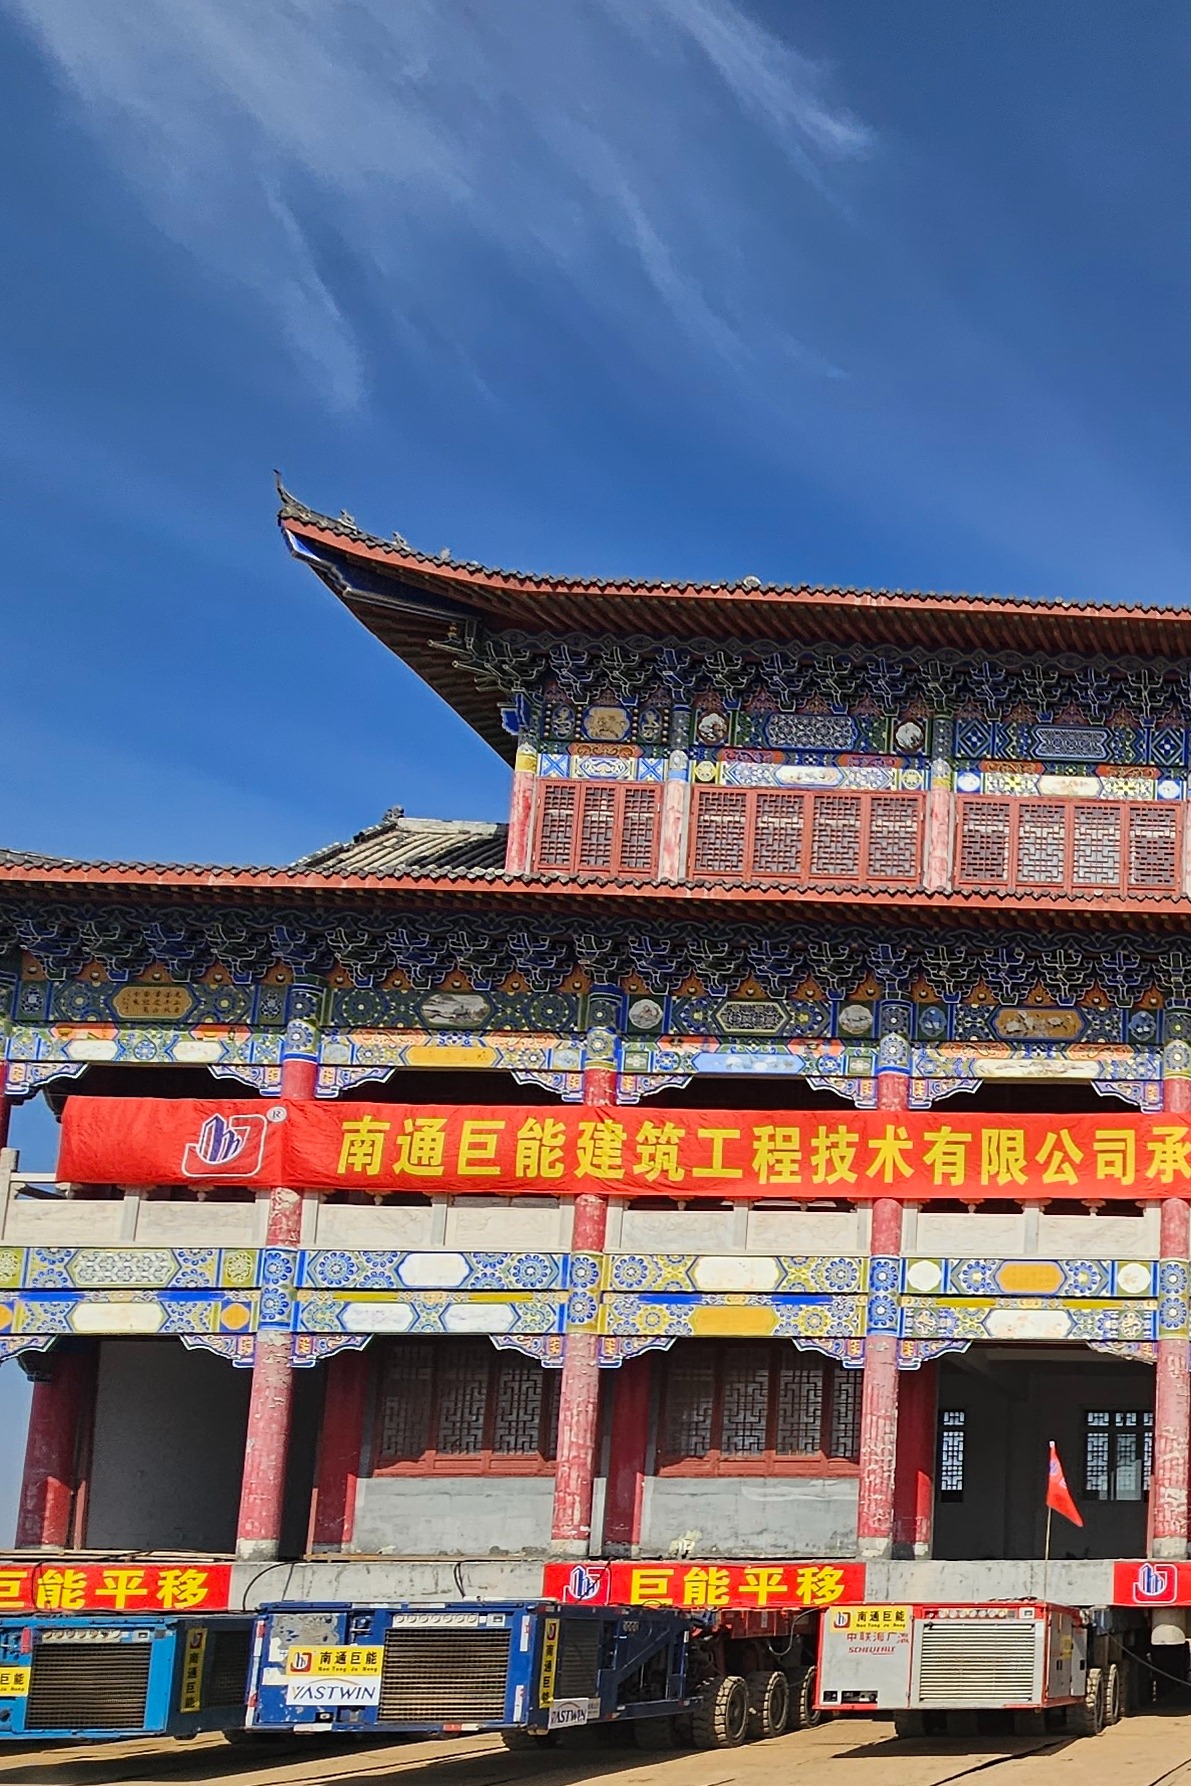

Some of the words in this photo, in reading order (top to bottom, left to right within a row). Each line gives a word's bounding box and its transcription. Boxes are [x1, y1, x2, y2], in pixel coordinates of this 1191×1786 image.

[630, 1566, 845, 1606] 巨能平移
[857, 1611, 905, 1622] 南通巨能
[319, 1651, 378, 1665] 南通巨能
